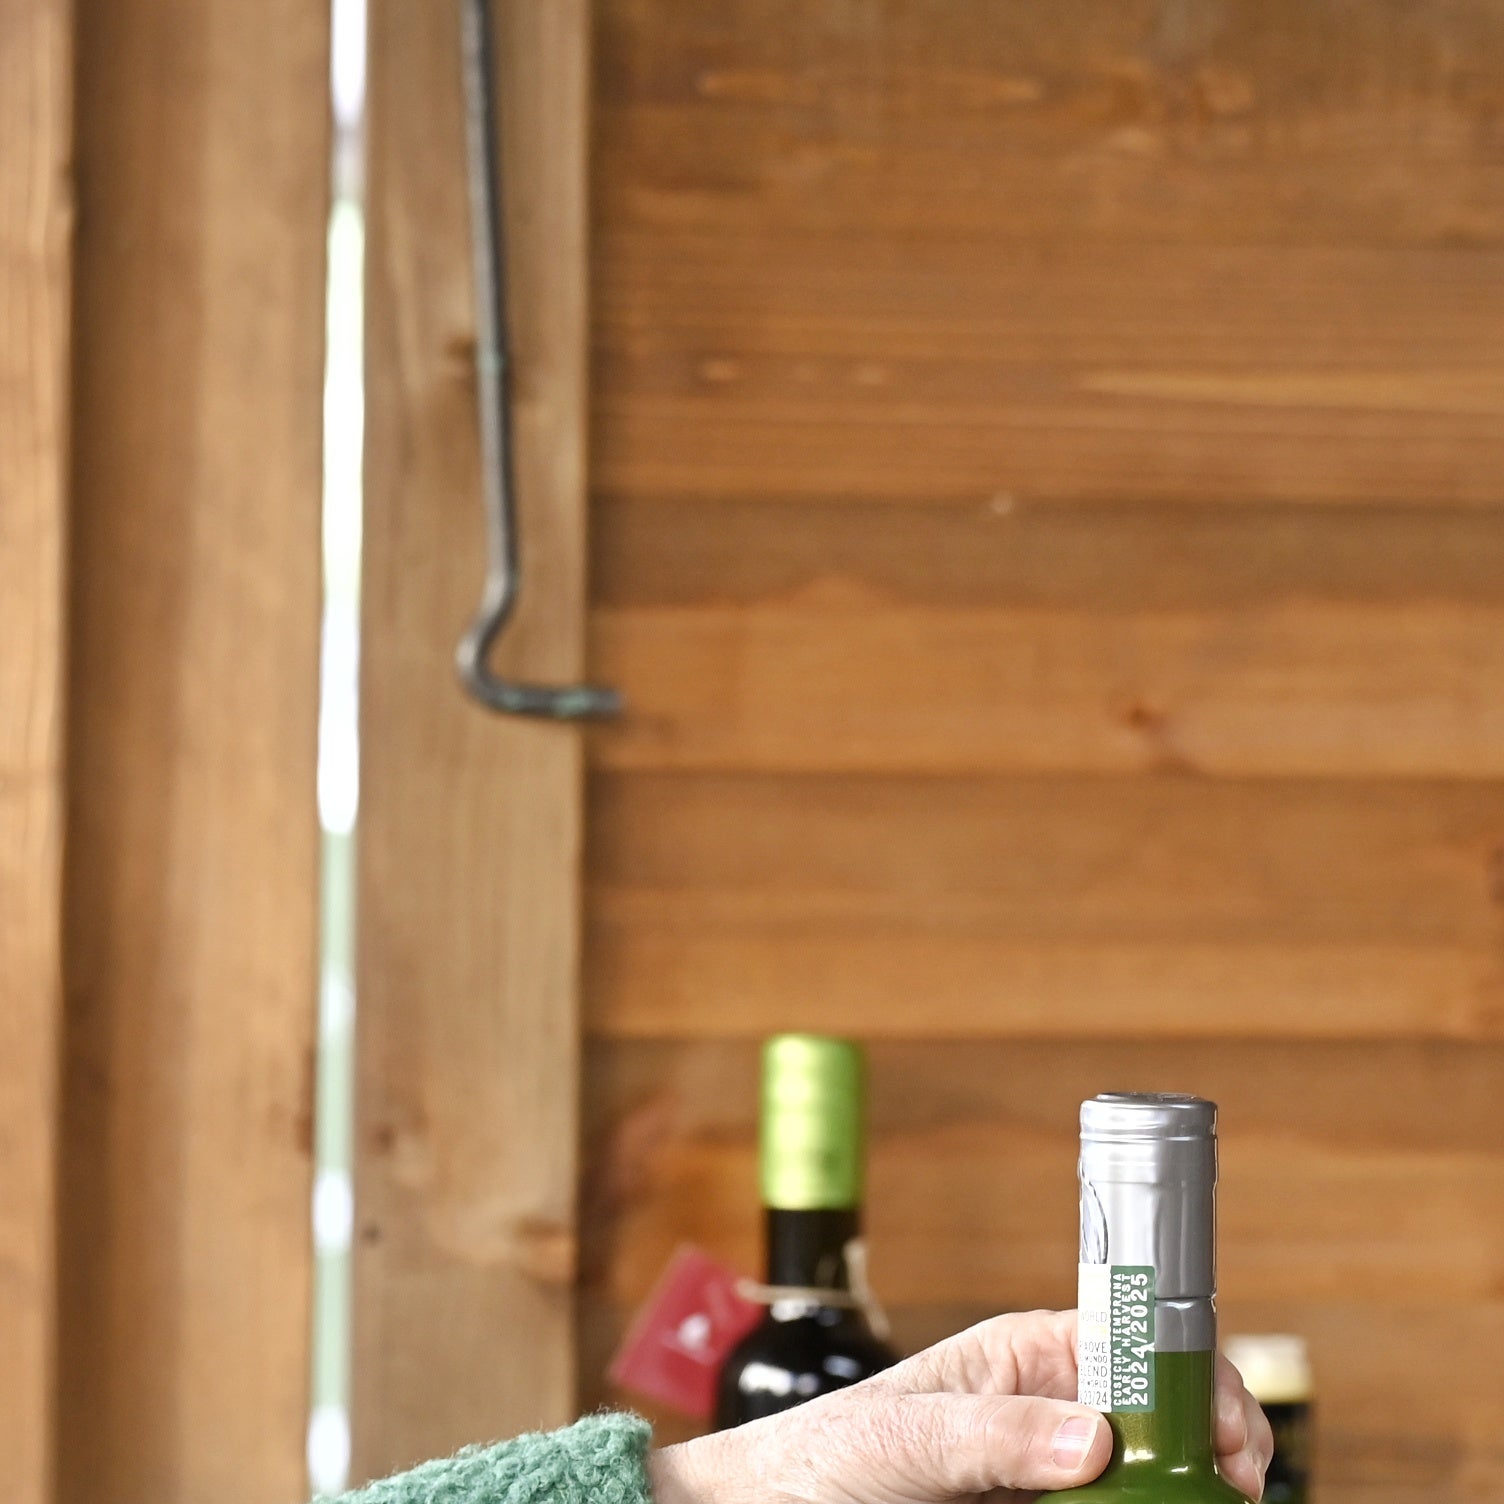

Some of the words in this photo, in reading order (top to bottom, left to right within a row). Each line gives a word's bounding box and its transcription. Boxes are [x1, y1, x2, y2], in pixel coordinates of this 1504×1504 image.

[1113, 1273, 1122, 1342] TEMPRANA
[1122, 1274, 1131, 1347] HARVEST
[1130, 1273, 1149, 1406] 2024/2025
[1113, 1348, 1122, 1406] COSECHA
[1122, 1356, 1131, 1406] EARLY
